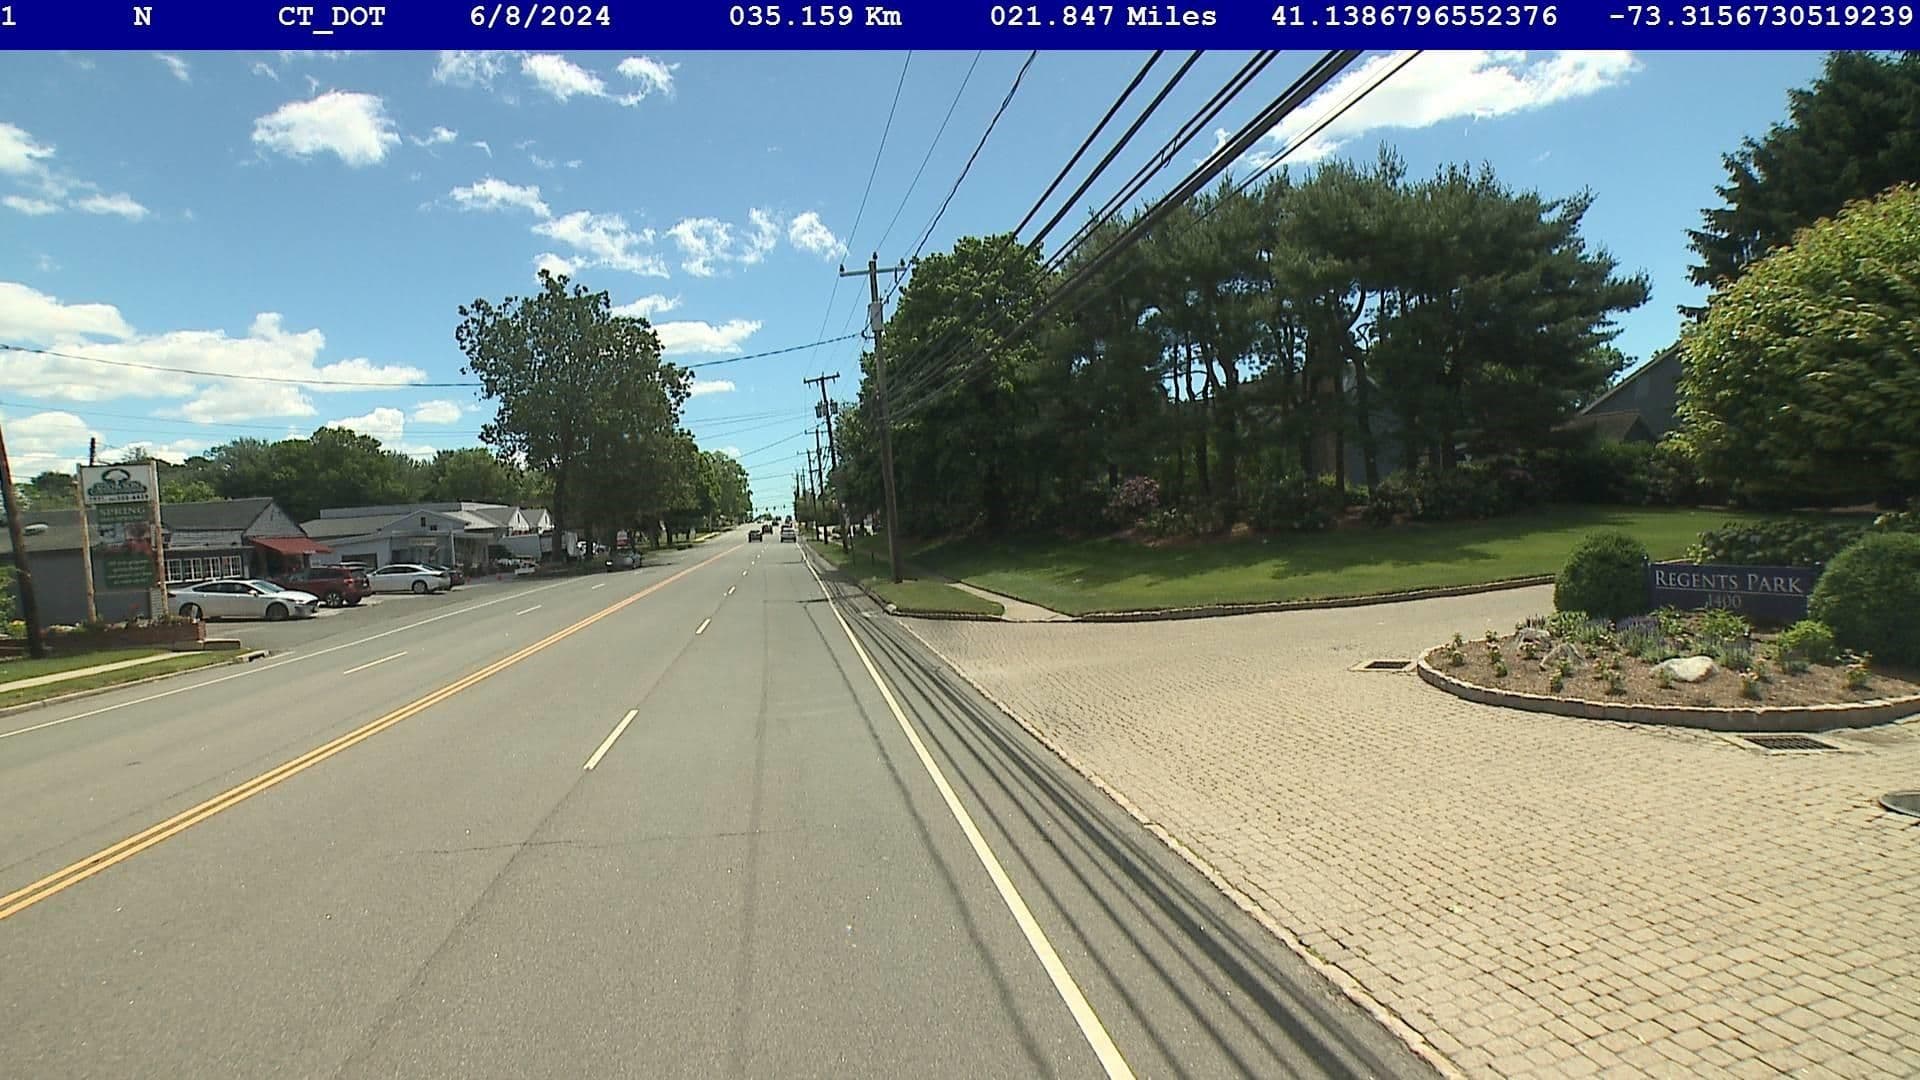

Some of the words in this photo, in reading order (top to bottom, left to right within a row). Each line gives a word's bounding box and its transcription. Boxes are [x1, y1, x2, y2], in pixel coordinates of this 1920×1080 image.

[99, 506, 146, 516] SPRING
[1655, 569, 1738, 590] REGENTS
[1747, 573, 1804, 593] PARK
[1706, 593, 1742, 609] 1400
